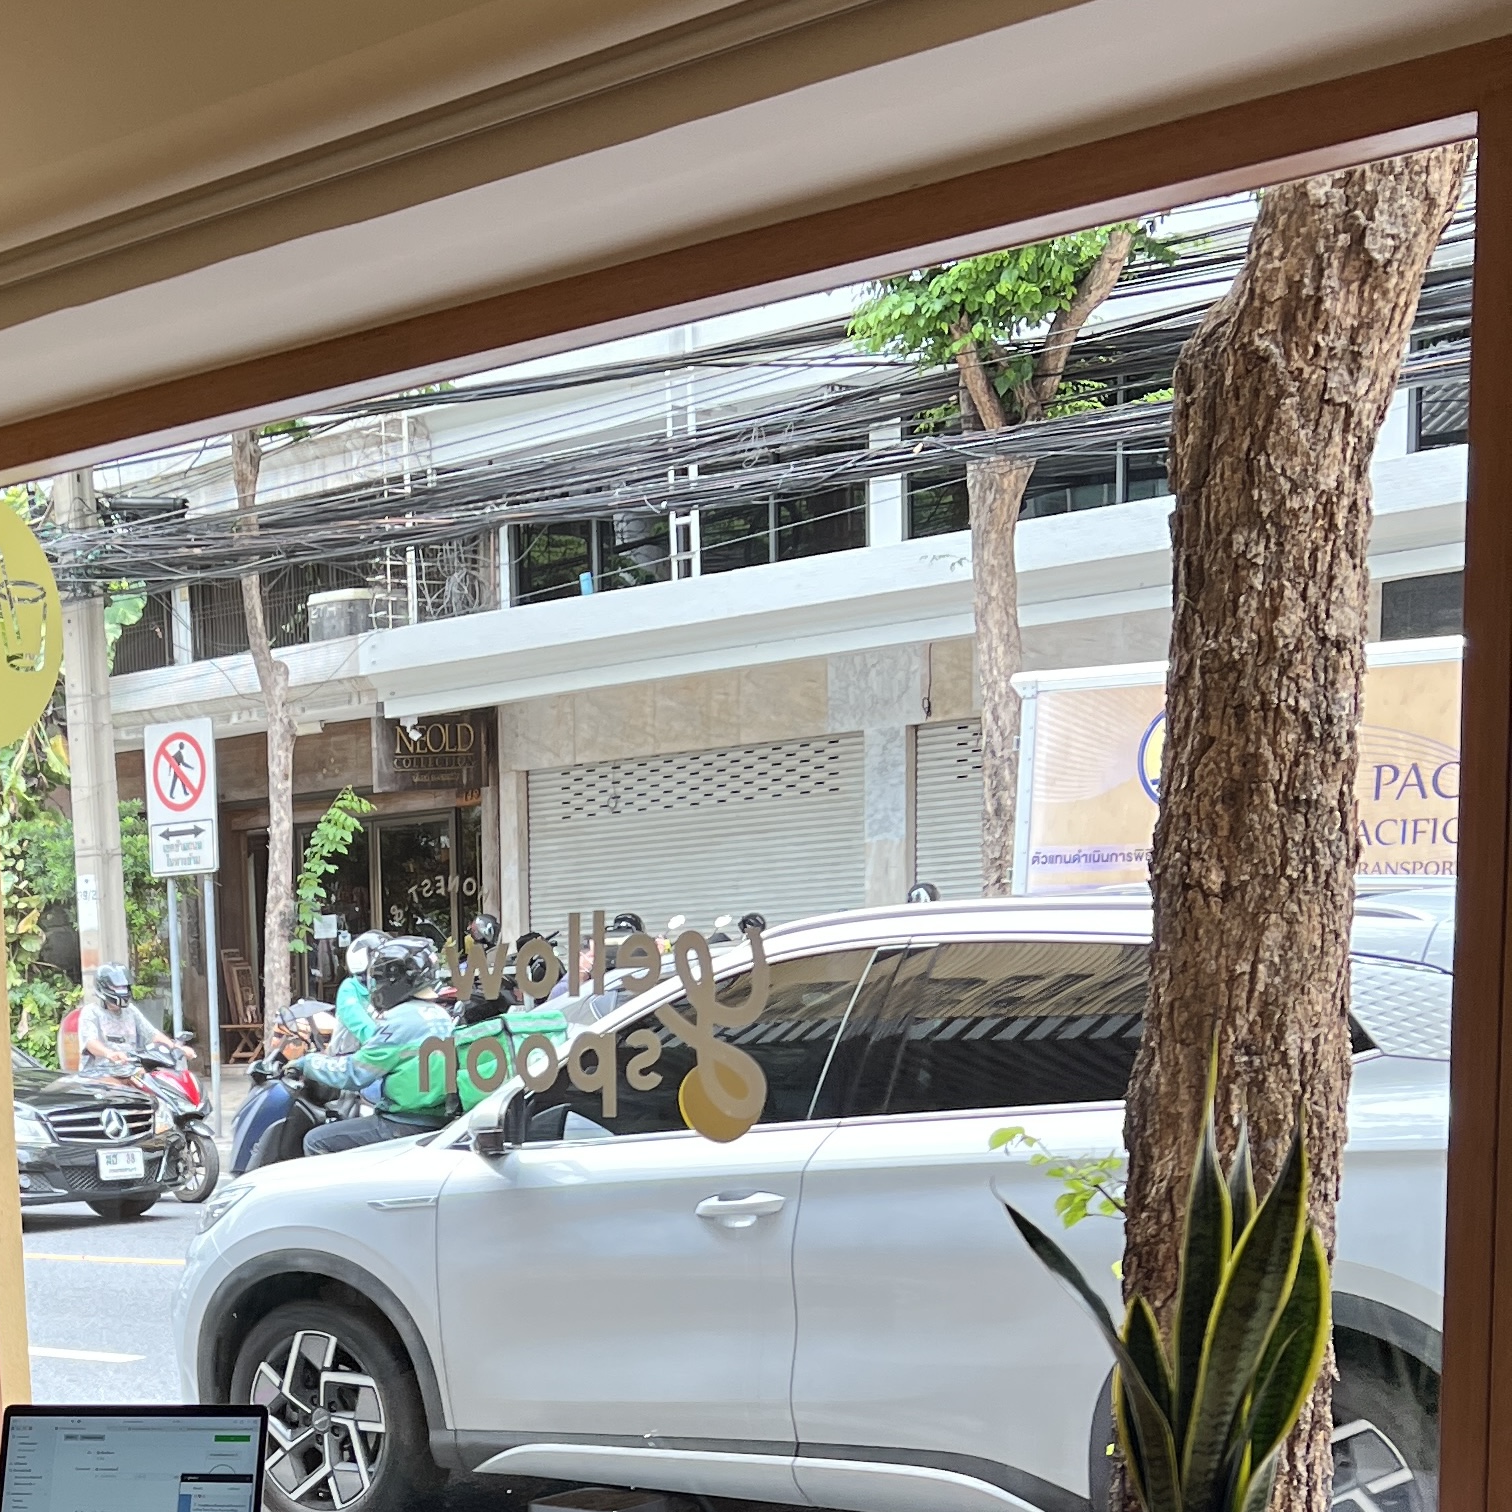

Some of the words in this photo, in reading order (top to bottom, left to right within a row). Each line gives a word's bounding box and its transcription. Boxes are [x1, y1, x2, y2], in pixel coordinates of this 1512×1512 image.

[395, 722, 475, 754] NEOLD
[1357, 816, 1459, 847] ACIFIC
[1357, 860, 1457, 876] RANSPOR
